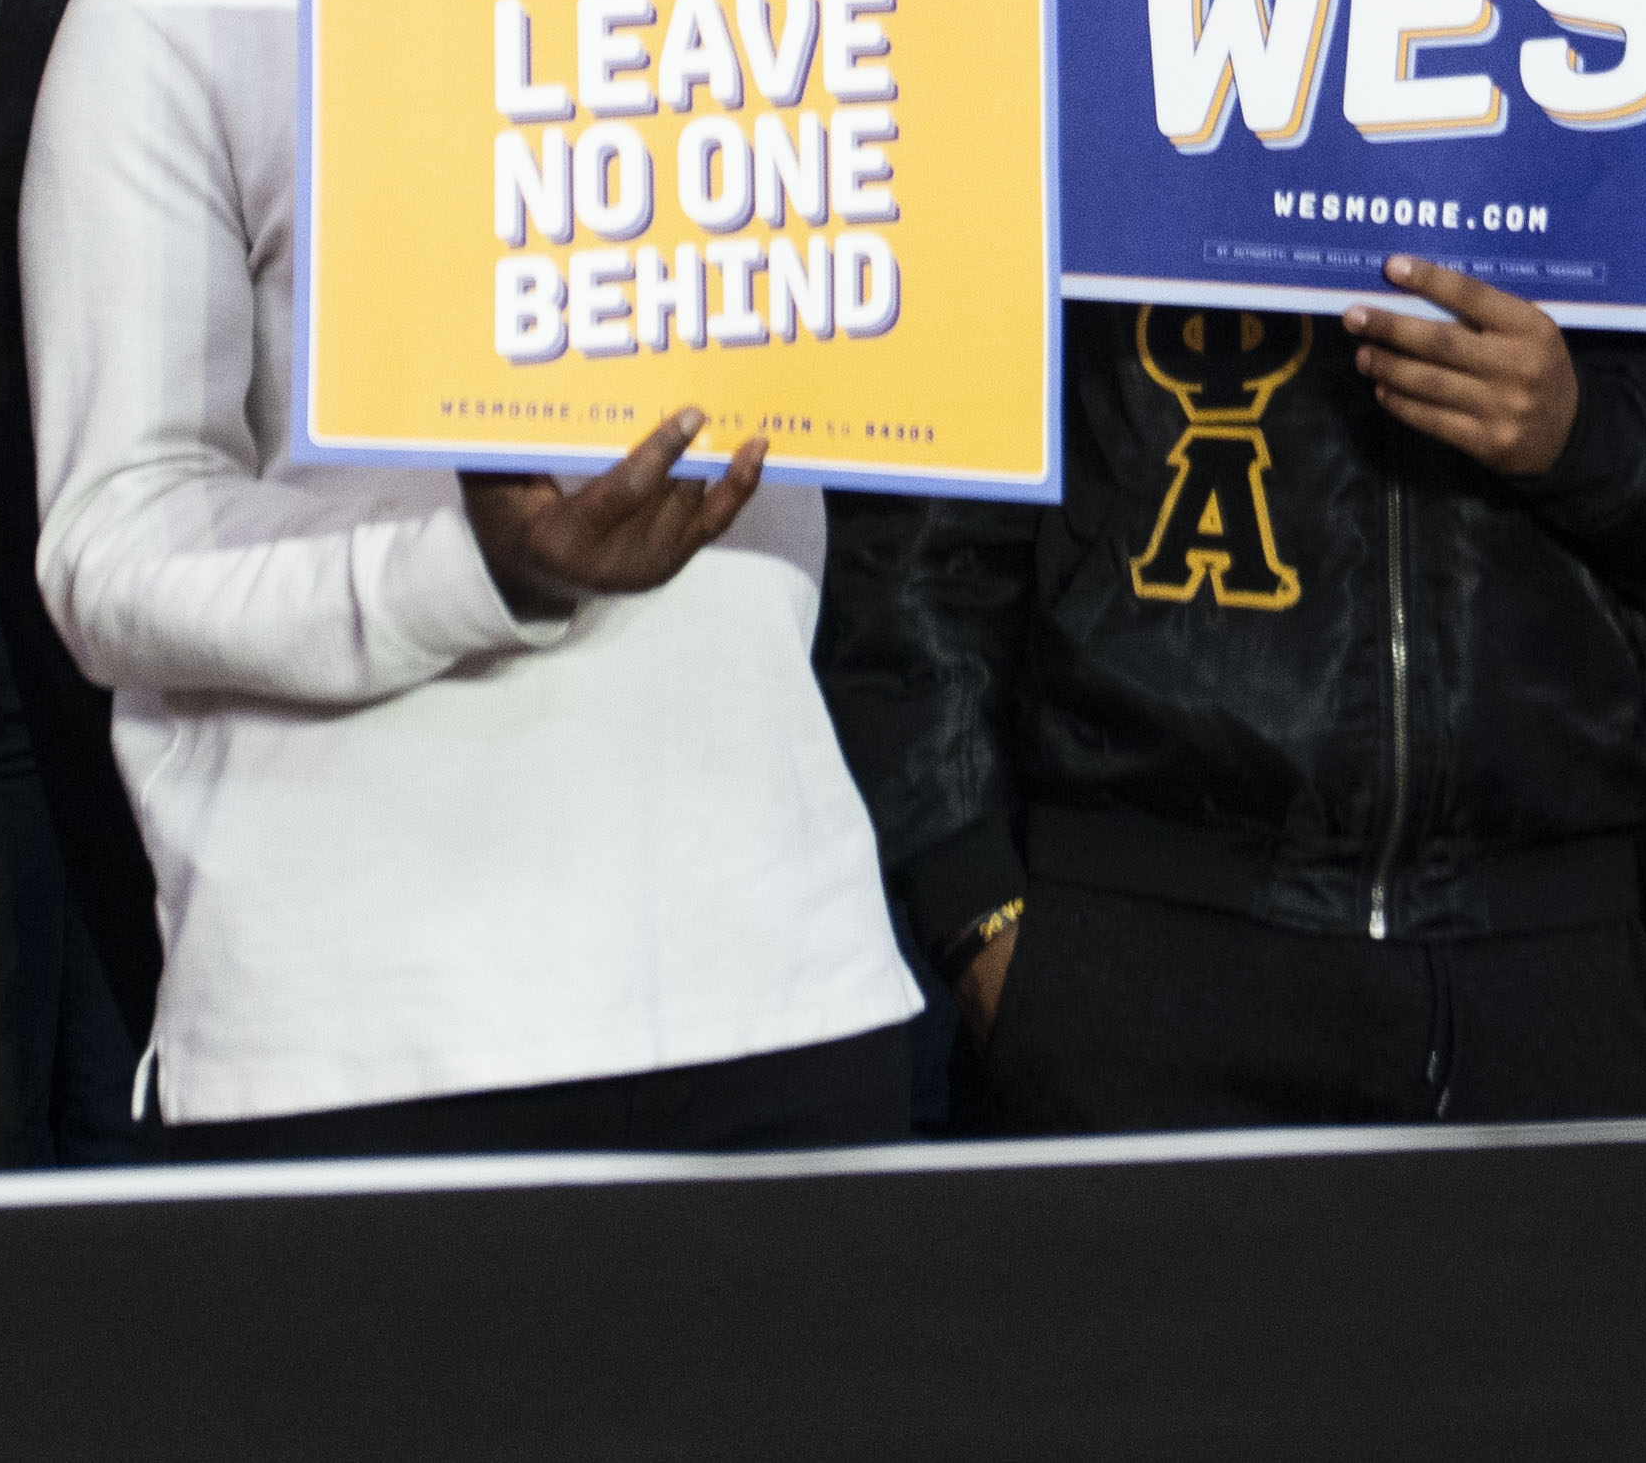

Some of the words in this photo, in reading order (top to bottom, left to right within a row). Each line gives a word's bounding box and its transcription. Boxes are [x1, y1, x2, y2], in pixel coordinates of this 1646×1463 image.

[493, 120, 655, 248] NO
[677, 106, 900, 234] ONE
[1273, 190, 1549, 234] WESMOORE.COM
[493, 231, 901, 367] BEHIND
[440, 400, 637, 424] WESMOORE.COM
[755, 412, 813, 434] JOIN
